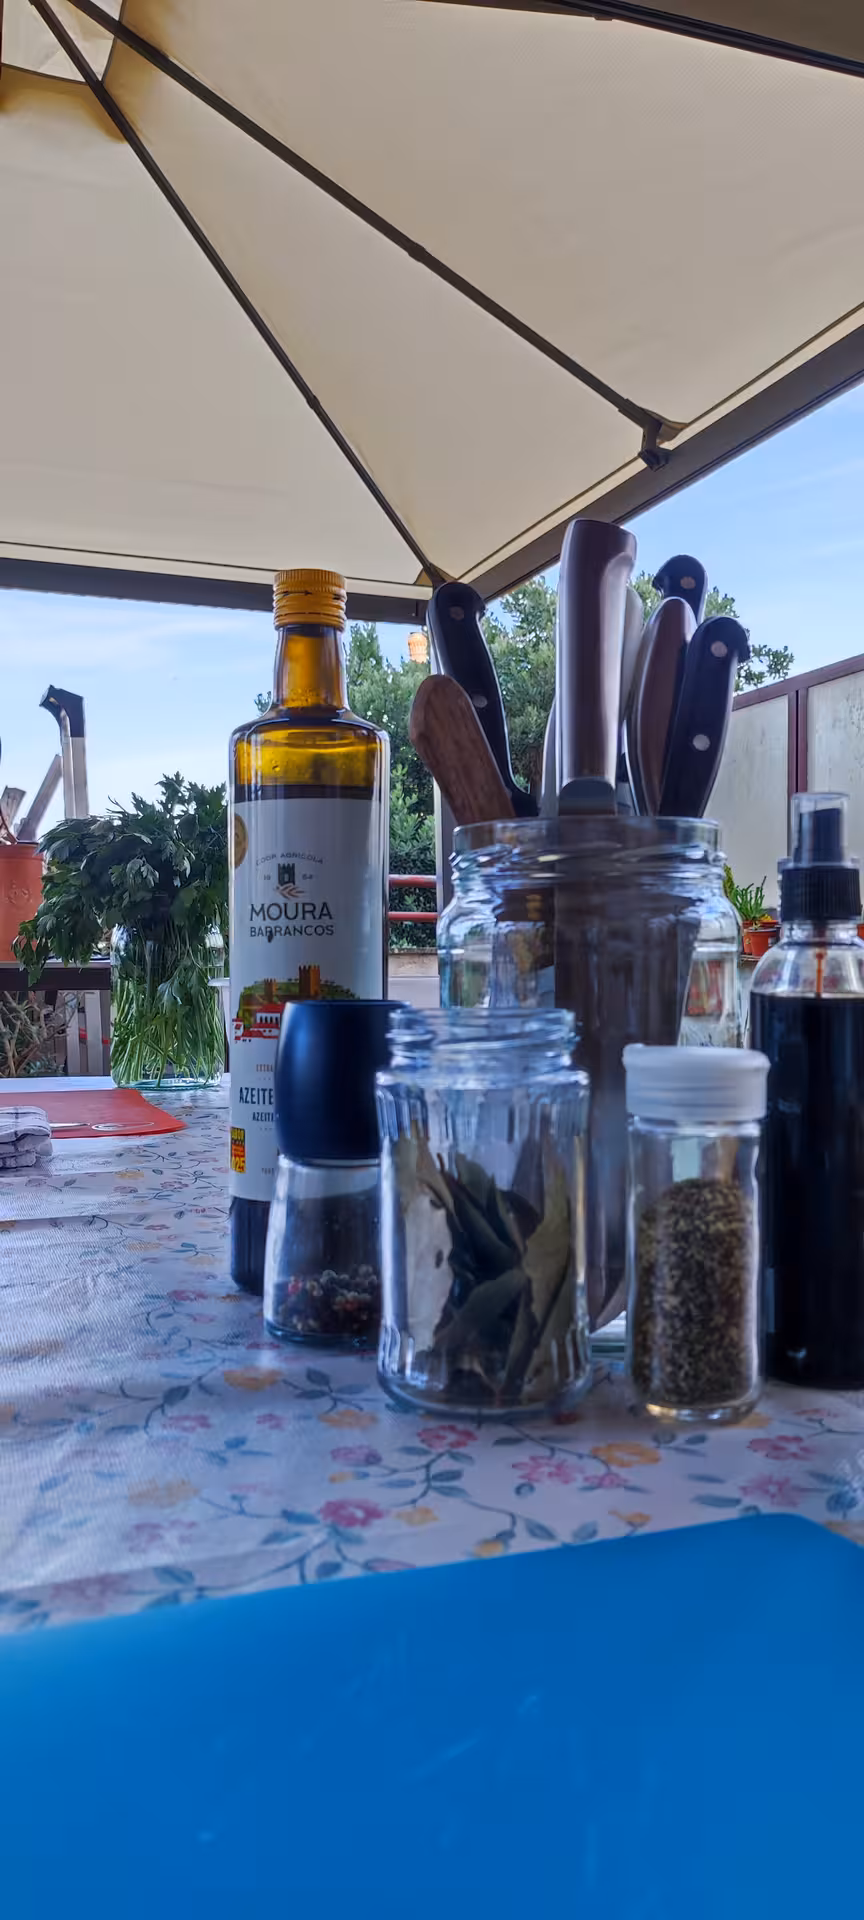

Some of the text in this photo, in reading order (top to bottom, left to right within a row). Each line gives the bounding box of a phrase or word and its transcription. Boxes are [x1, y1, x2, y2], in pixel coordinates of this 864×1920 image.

[250, 901, 333, 921] MOURA
[250, 924, 334, 938] BARRANCOS
[239, 1086, 274, 1105] AZEITE
[231, 1156, 246, 1173] 025
